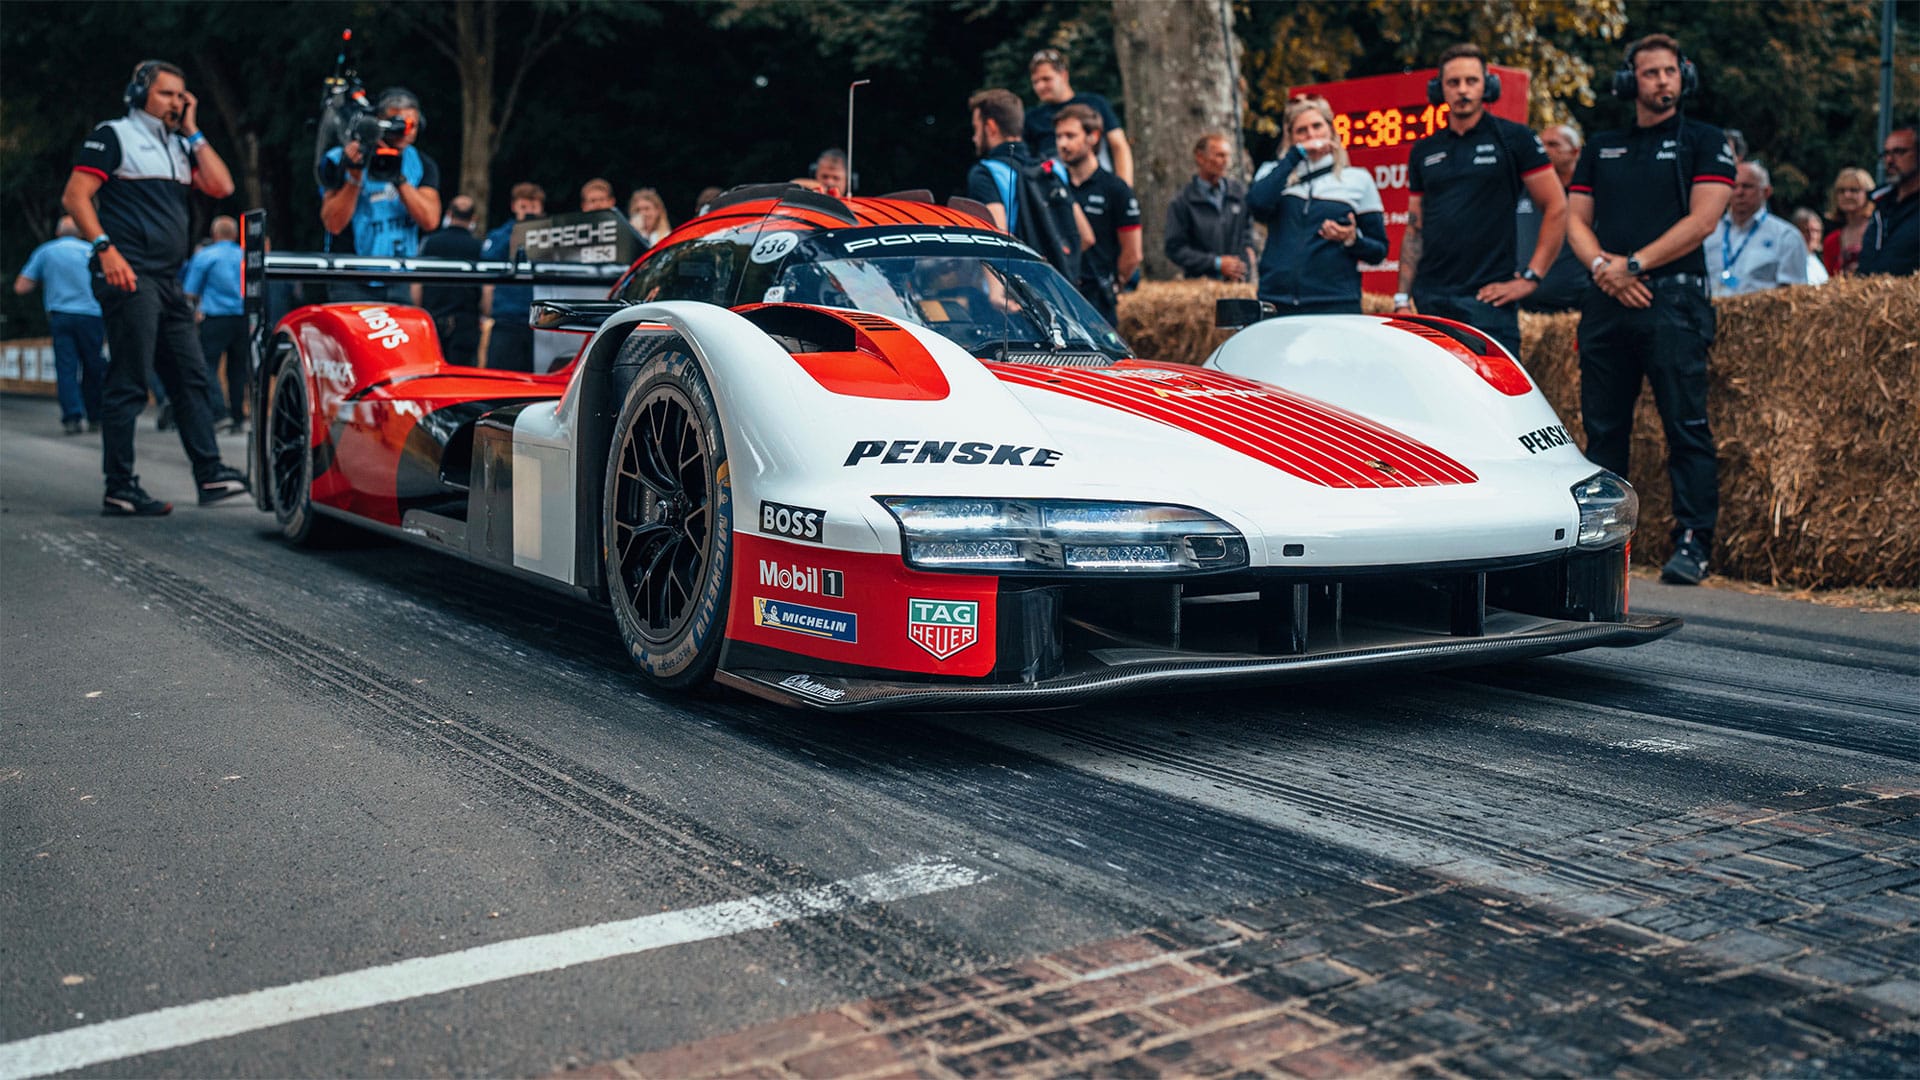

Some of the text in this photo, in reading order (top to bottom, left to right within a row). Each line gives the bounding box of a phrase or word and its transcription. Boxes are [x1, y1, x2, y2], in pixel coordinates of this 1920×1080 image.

[1375, 164, 1410, 189] DU
[525, 221, 617, 249] PORSCHE
[757, 238, 790, 256] 536
[581, 245, 617, 263] 963
[352, 306, 409, 349] nsys
[1518, 424, 1574, 454] PENSK
[843, 440, 1063, 467] PENSKE
[763, 506, 818, 538] BOSS
[694, 513, 728, 639] MICHELIN
[759, 560, 818, 593] Mobil
[782, 612, 847, 632] MICHELIN
[915, 603, 971, 623] TAG
[913, 625, 972, 654] HEUER
